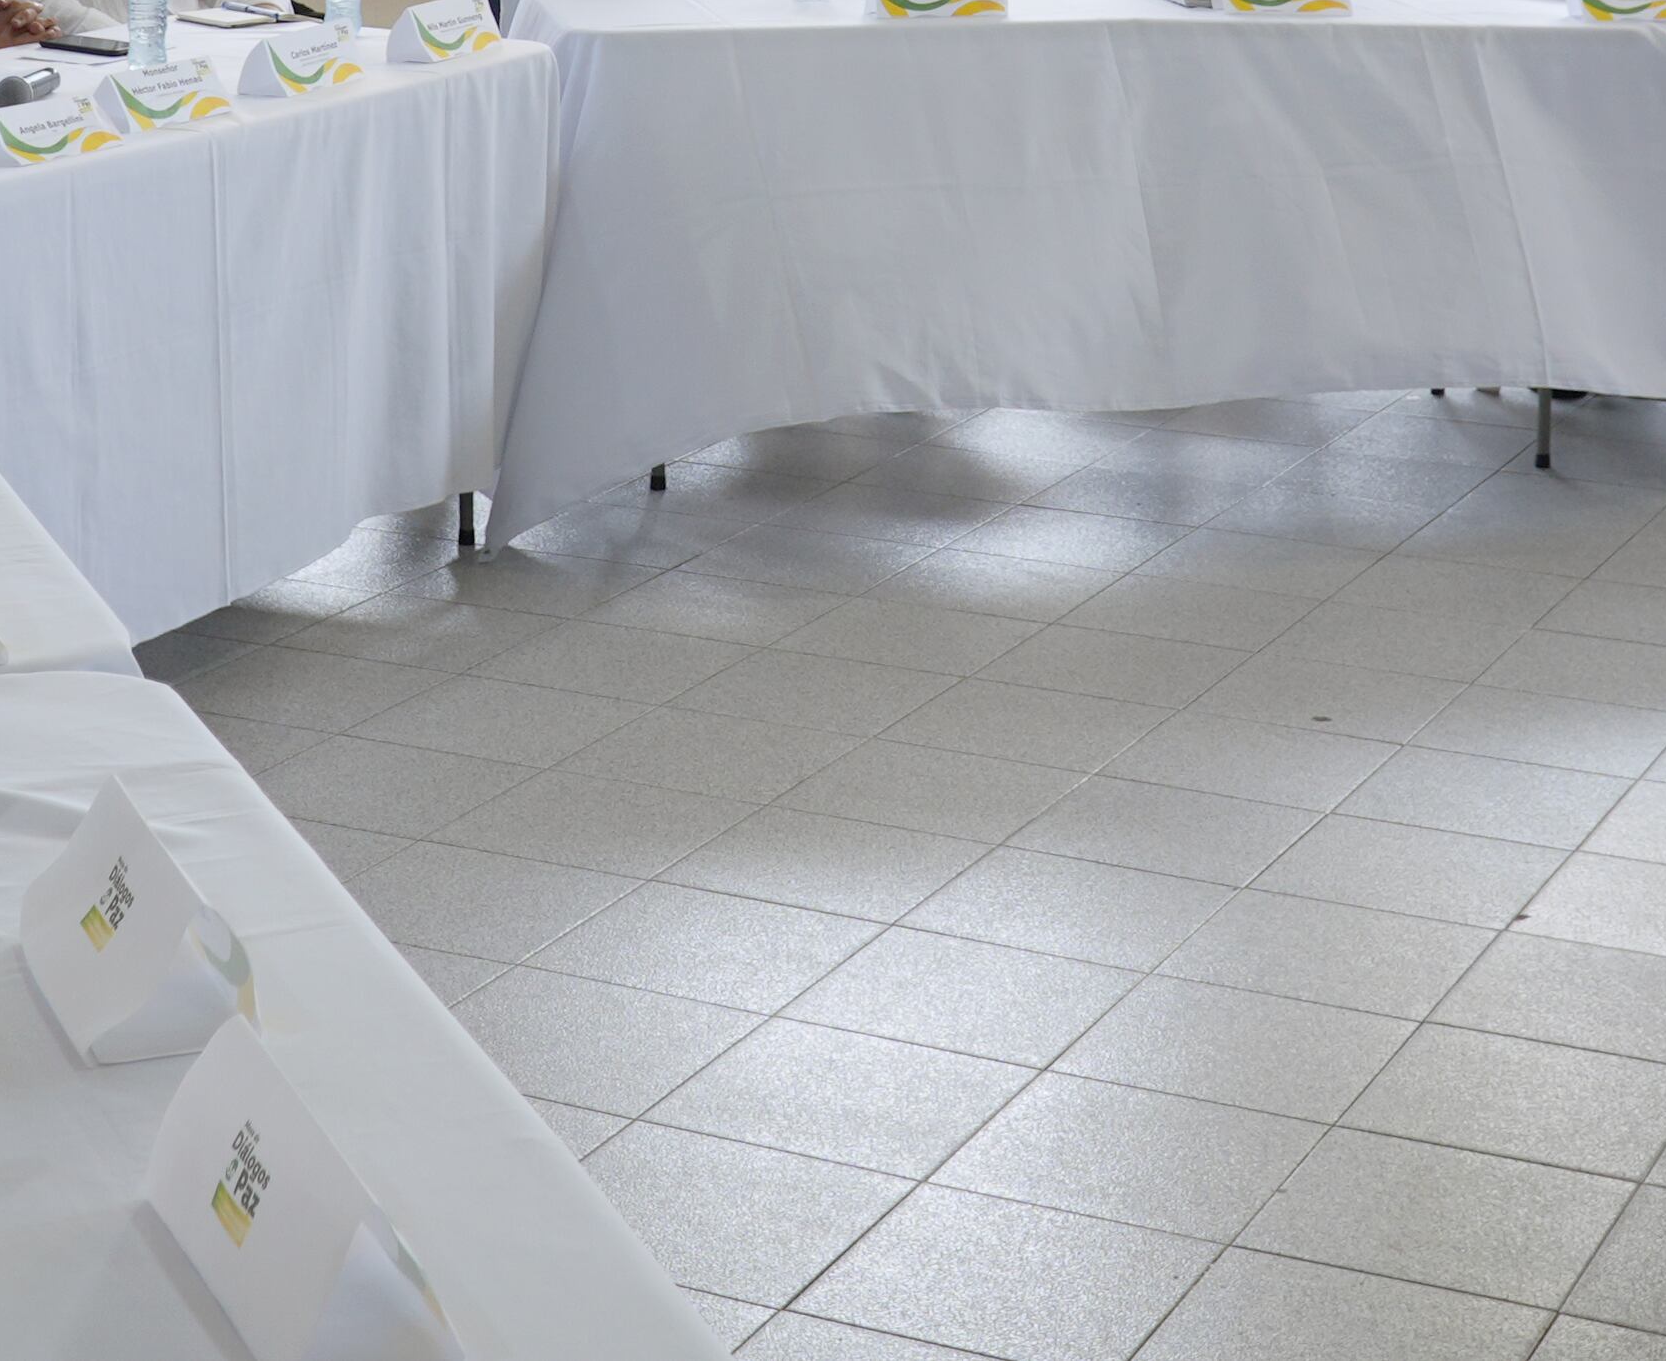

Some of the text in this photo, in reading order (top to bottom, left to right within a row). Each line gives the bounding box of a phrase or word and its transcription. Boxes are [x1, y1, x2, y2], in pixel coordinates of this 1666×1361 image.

[142, 64, 178, 77] Monseñor
[157, 81, 178, 91] Fabio
[19, 122, 47, 135] Angela
[104, 893, 126, 932] Paz
[232, 1129, 271, 1191] Diálogos
[233, 1167, 261, 1220] Paz
